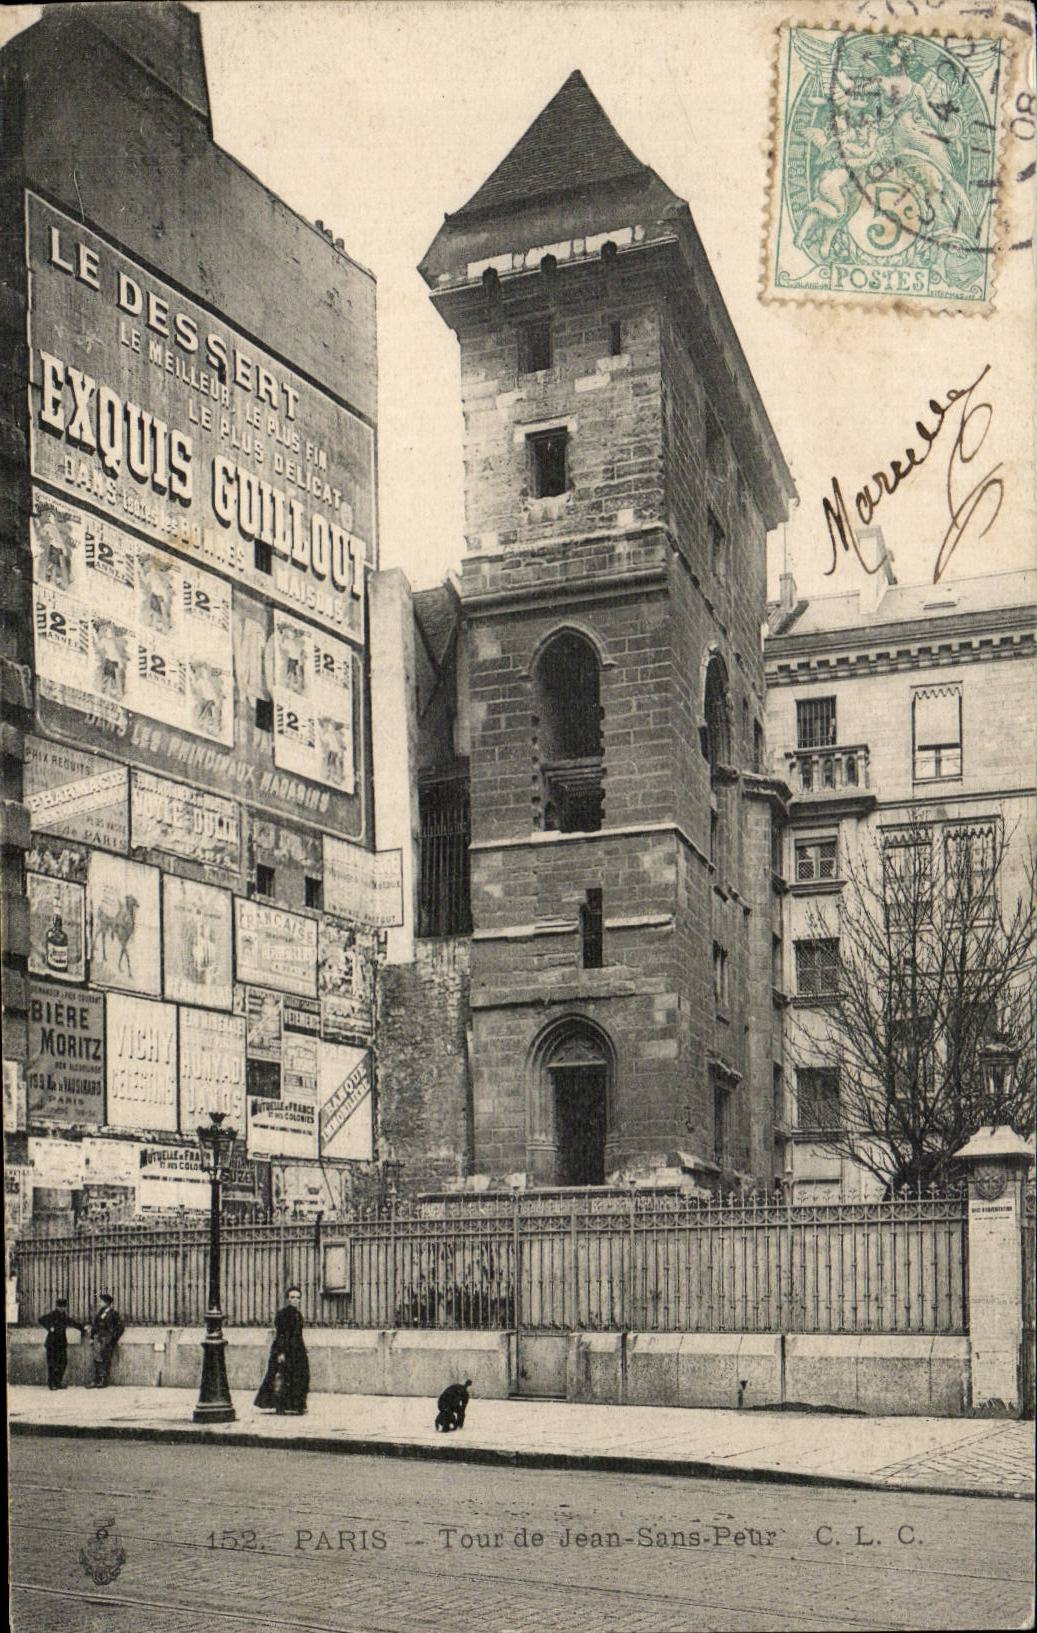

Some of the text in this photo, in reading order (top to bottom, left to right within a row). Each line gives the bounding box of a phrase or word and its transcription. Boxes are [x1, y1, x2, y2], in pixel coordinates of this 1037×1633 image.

[834, 267, 925, 291] POSTES
[50, 225, 299, 421] LE DESSERT
[120, 321, 141, 353] LE
[246, 403, 262, 431] LE
[267, 415, 301, 455] PLUS
[305, 440, 327, 472] FIN
[188, 398, 212, 433] LE
[220, 414, 264, 465] PLUS
[38, 349, 367, 601] EXQUIS GUILLOUT
[65, 455, 116, 506] DANS
[31, 1000, 90, 1030] BIÈRE
[40, 1026, 102, 1061] MORITZ
[285, 1112, 315, 1124] COLONIES
